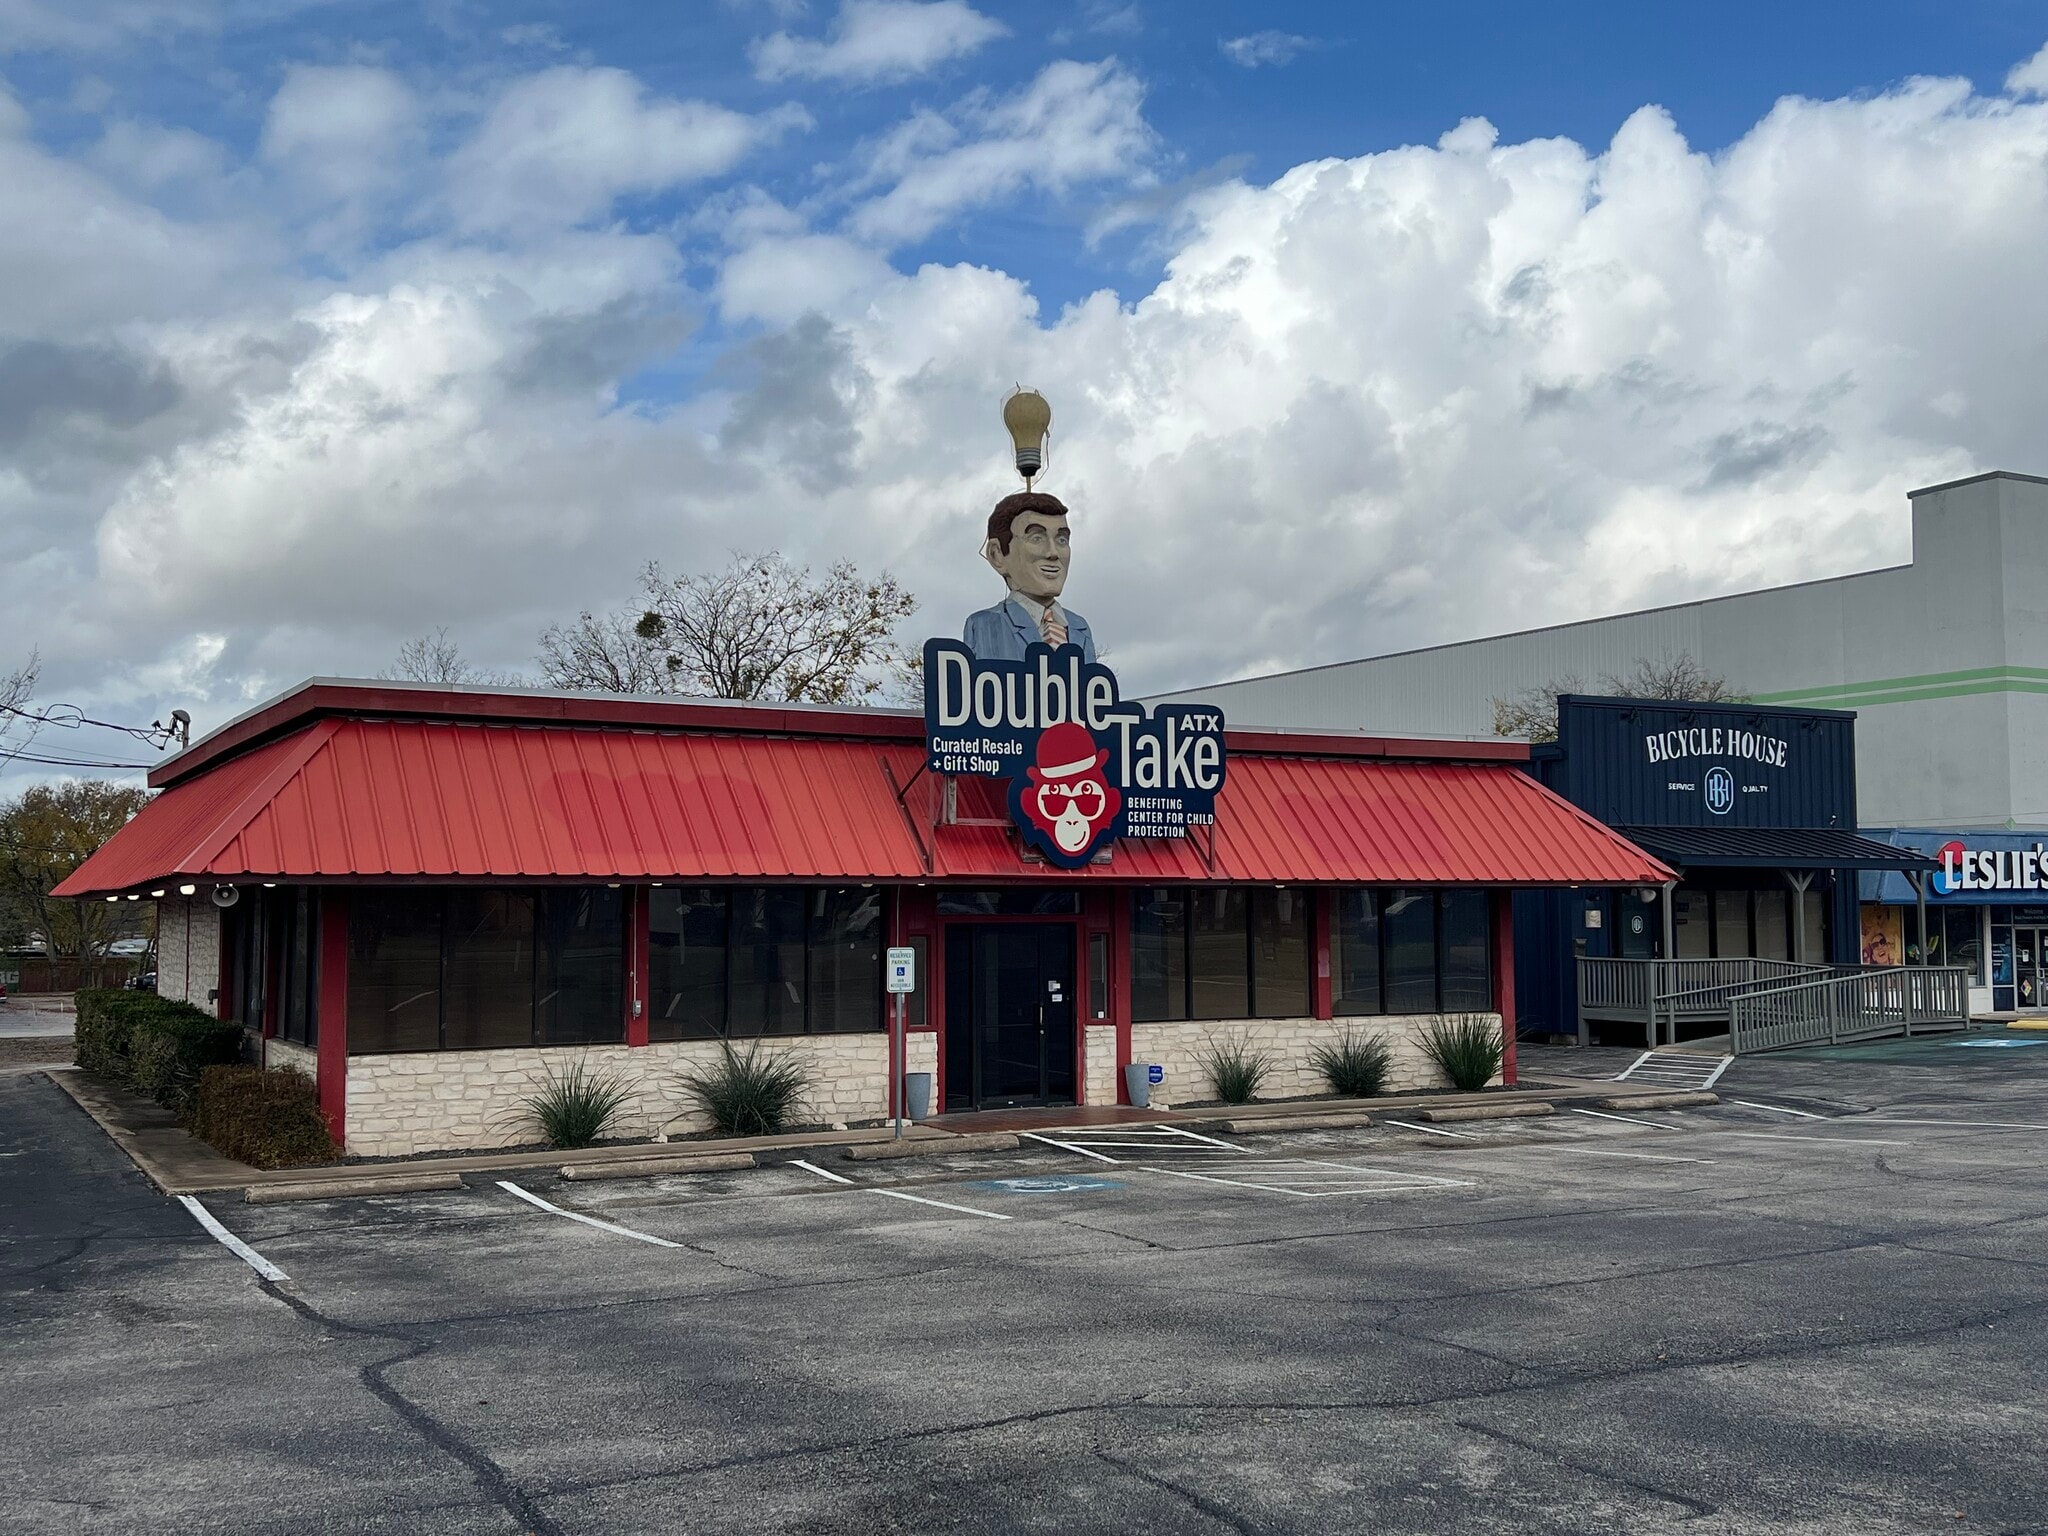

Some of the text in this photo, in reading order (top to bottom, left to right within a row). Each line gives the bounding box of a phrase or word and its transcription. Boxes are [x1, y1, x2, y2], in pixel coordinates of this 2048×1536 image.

[937, 650, 1113, 731] Double
[1180, 714, 1219, 732] ATX
[933, 736, 1023, 755] Curated Resale
[1104, 714, 1220, 790] Take
[1646, 728, 1788, 768] BICYCLE HOUSE
[943, 755, 967, 771] Gift
[970, 756, 999, 776] Shop
[1668, 782, 1695, 791] SERVICE
[1128, 797, 1183, 810] BENEFITING
[1128, 811, 1214, 825] CENTER FOR CHILD
[1128, 825, 1185, 838] PROTECTION
